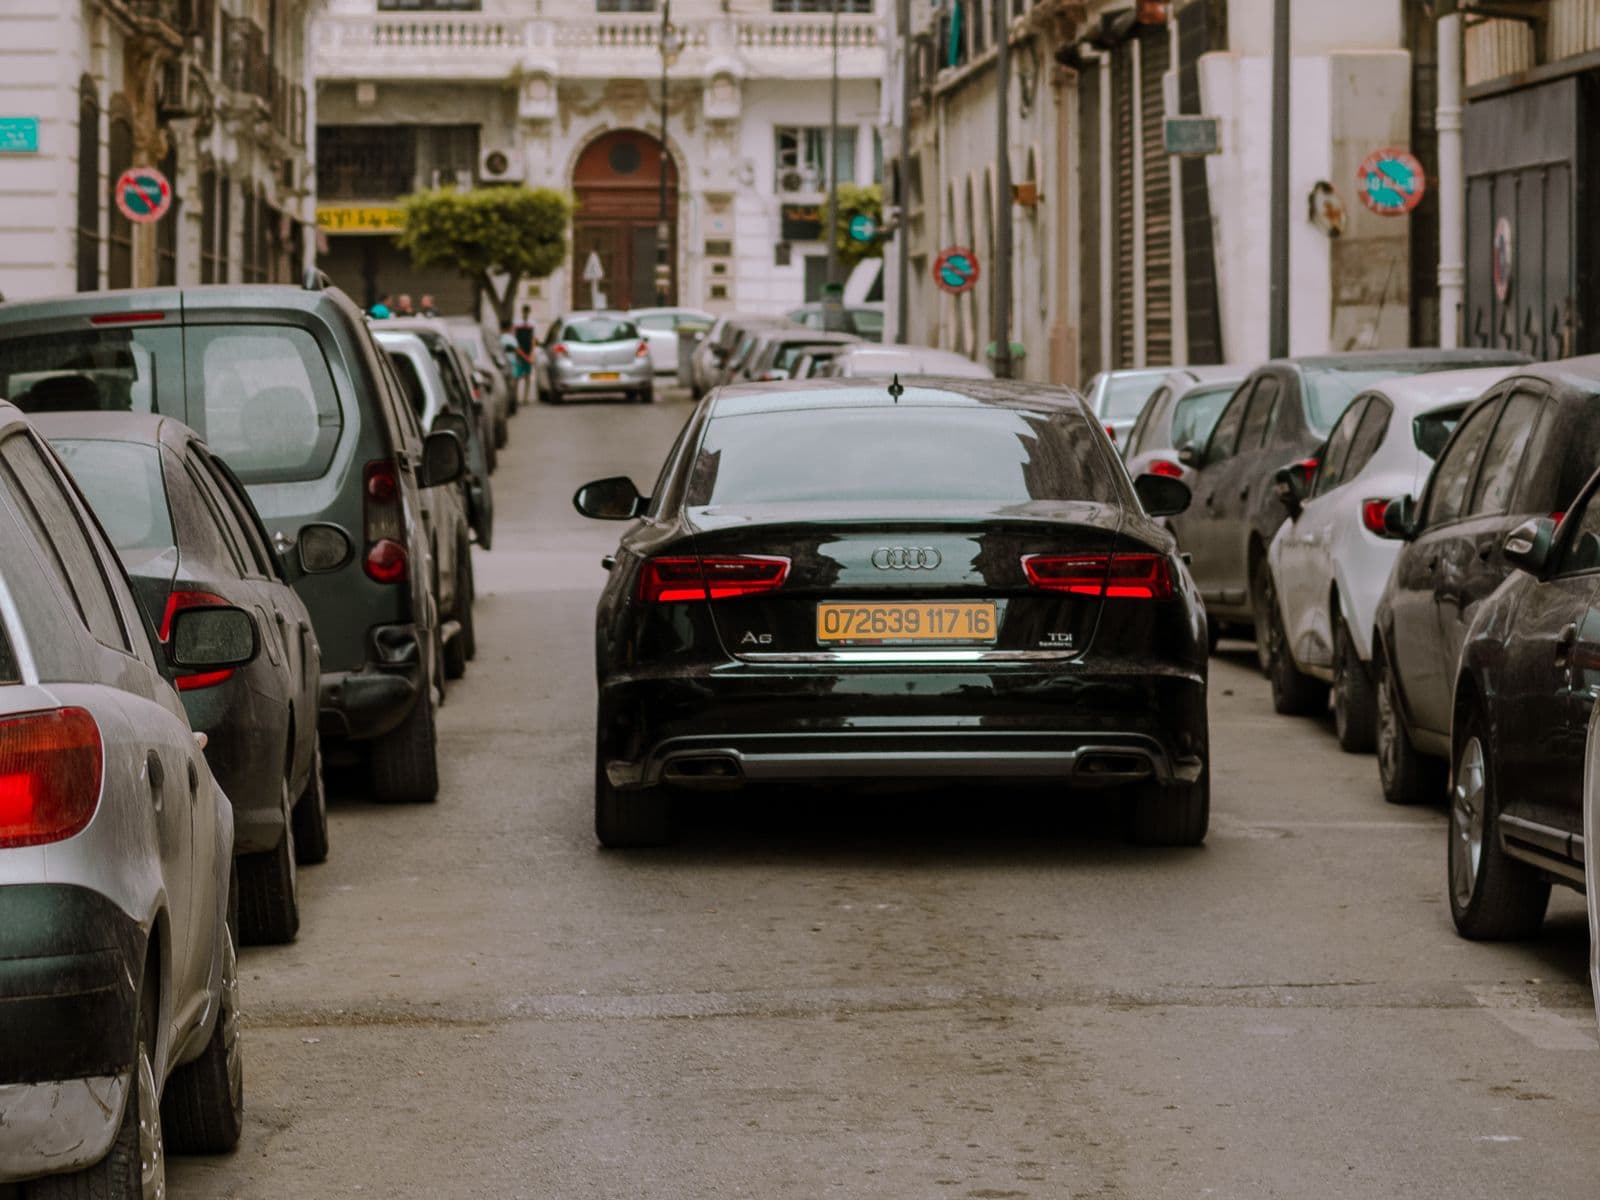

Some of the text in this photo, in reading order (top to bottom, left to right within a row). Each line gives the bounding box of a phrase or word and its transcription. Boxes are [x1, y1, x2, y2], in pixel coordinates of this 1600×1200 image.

[824, 608, 990, 634] 072639 117 16
[741, 631, 772, 644] A6
[1047, 633, 1073, 641] TDI
